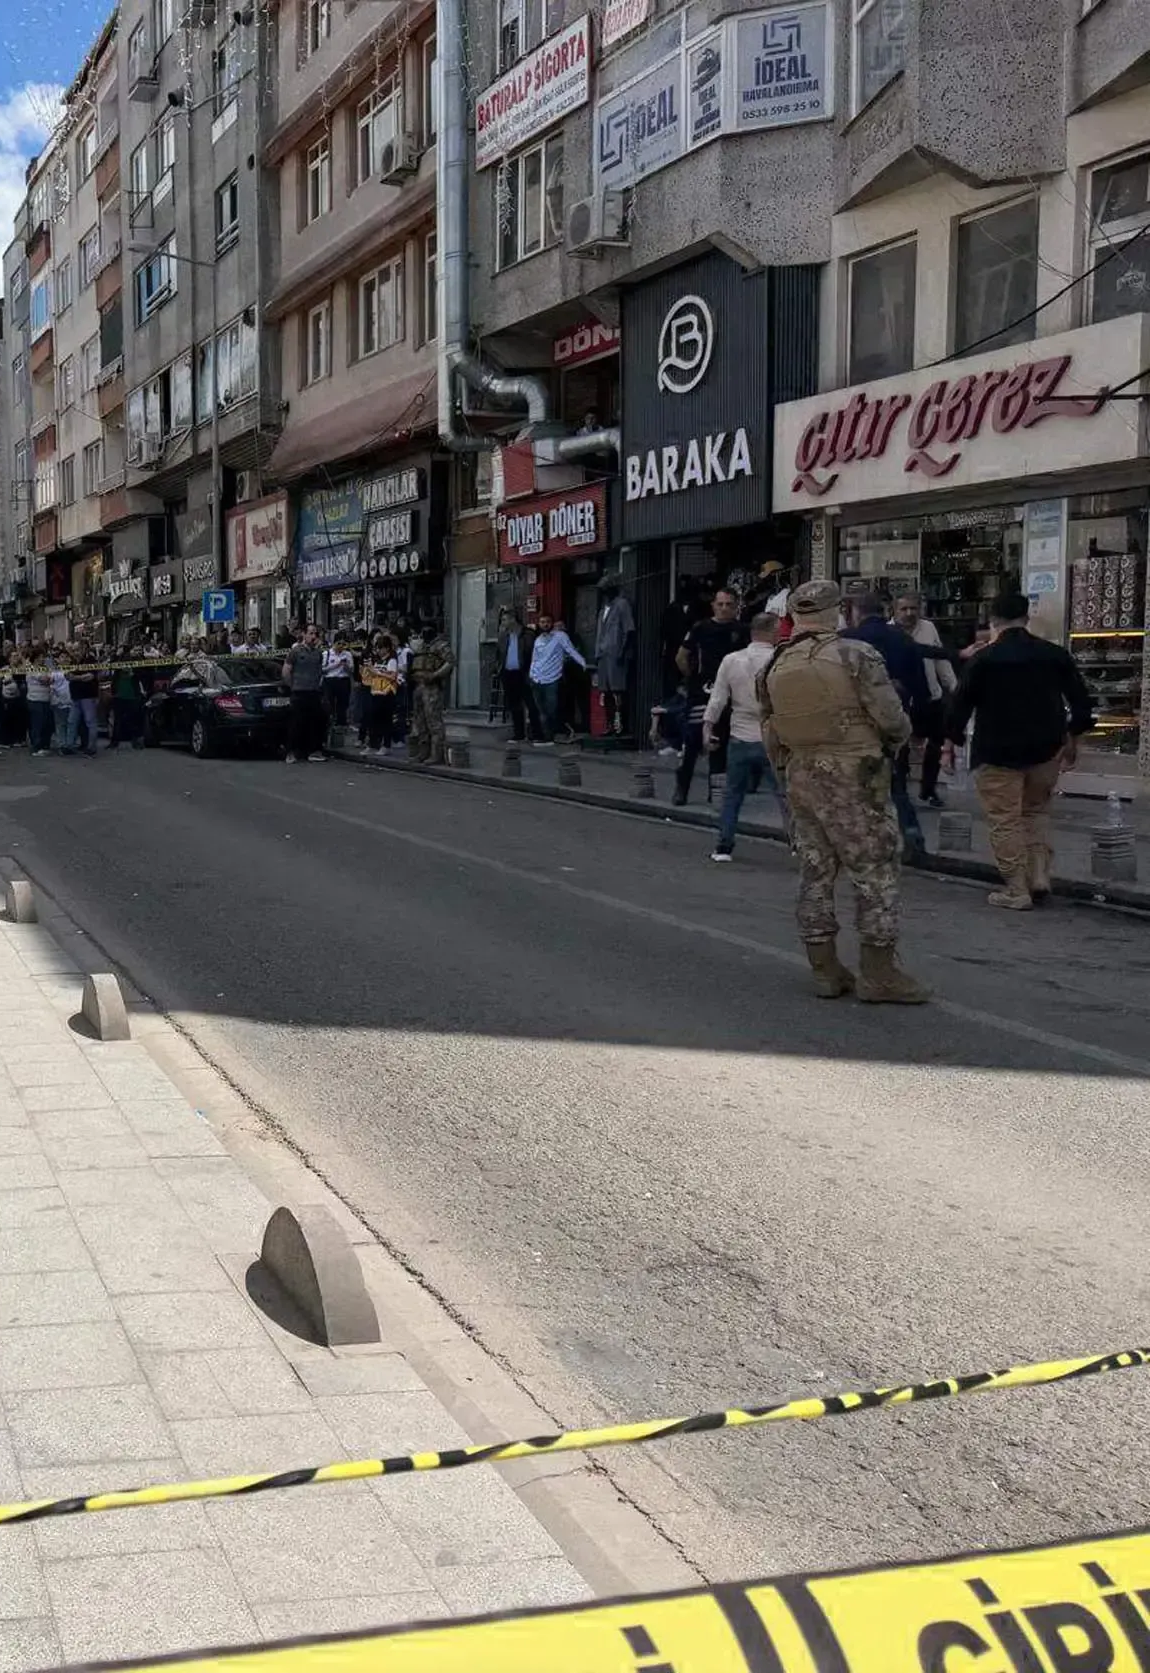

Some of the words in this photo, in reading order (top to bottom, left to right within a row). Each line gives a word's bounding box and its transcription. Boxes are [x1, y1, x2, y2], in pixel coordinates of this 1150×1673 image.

[477, 70, 533, 132] BATURALP
[534, 31, 586, 92] SİGORTA
[742, 79, 820, 103] HAVALANDIRMA
[754, 54, 812, 86] İDEAL
[554, 322, 621, 362] DÖN
[626, 427, 753, 502] BARAKA
[362, 467, 419, 513] HANCILAR
[507, 512, 544, 548] DİYAR
[549, 500, 595, 540] DÖNER
[209, 593, 227, 619] P
